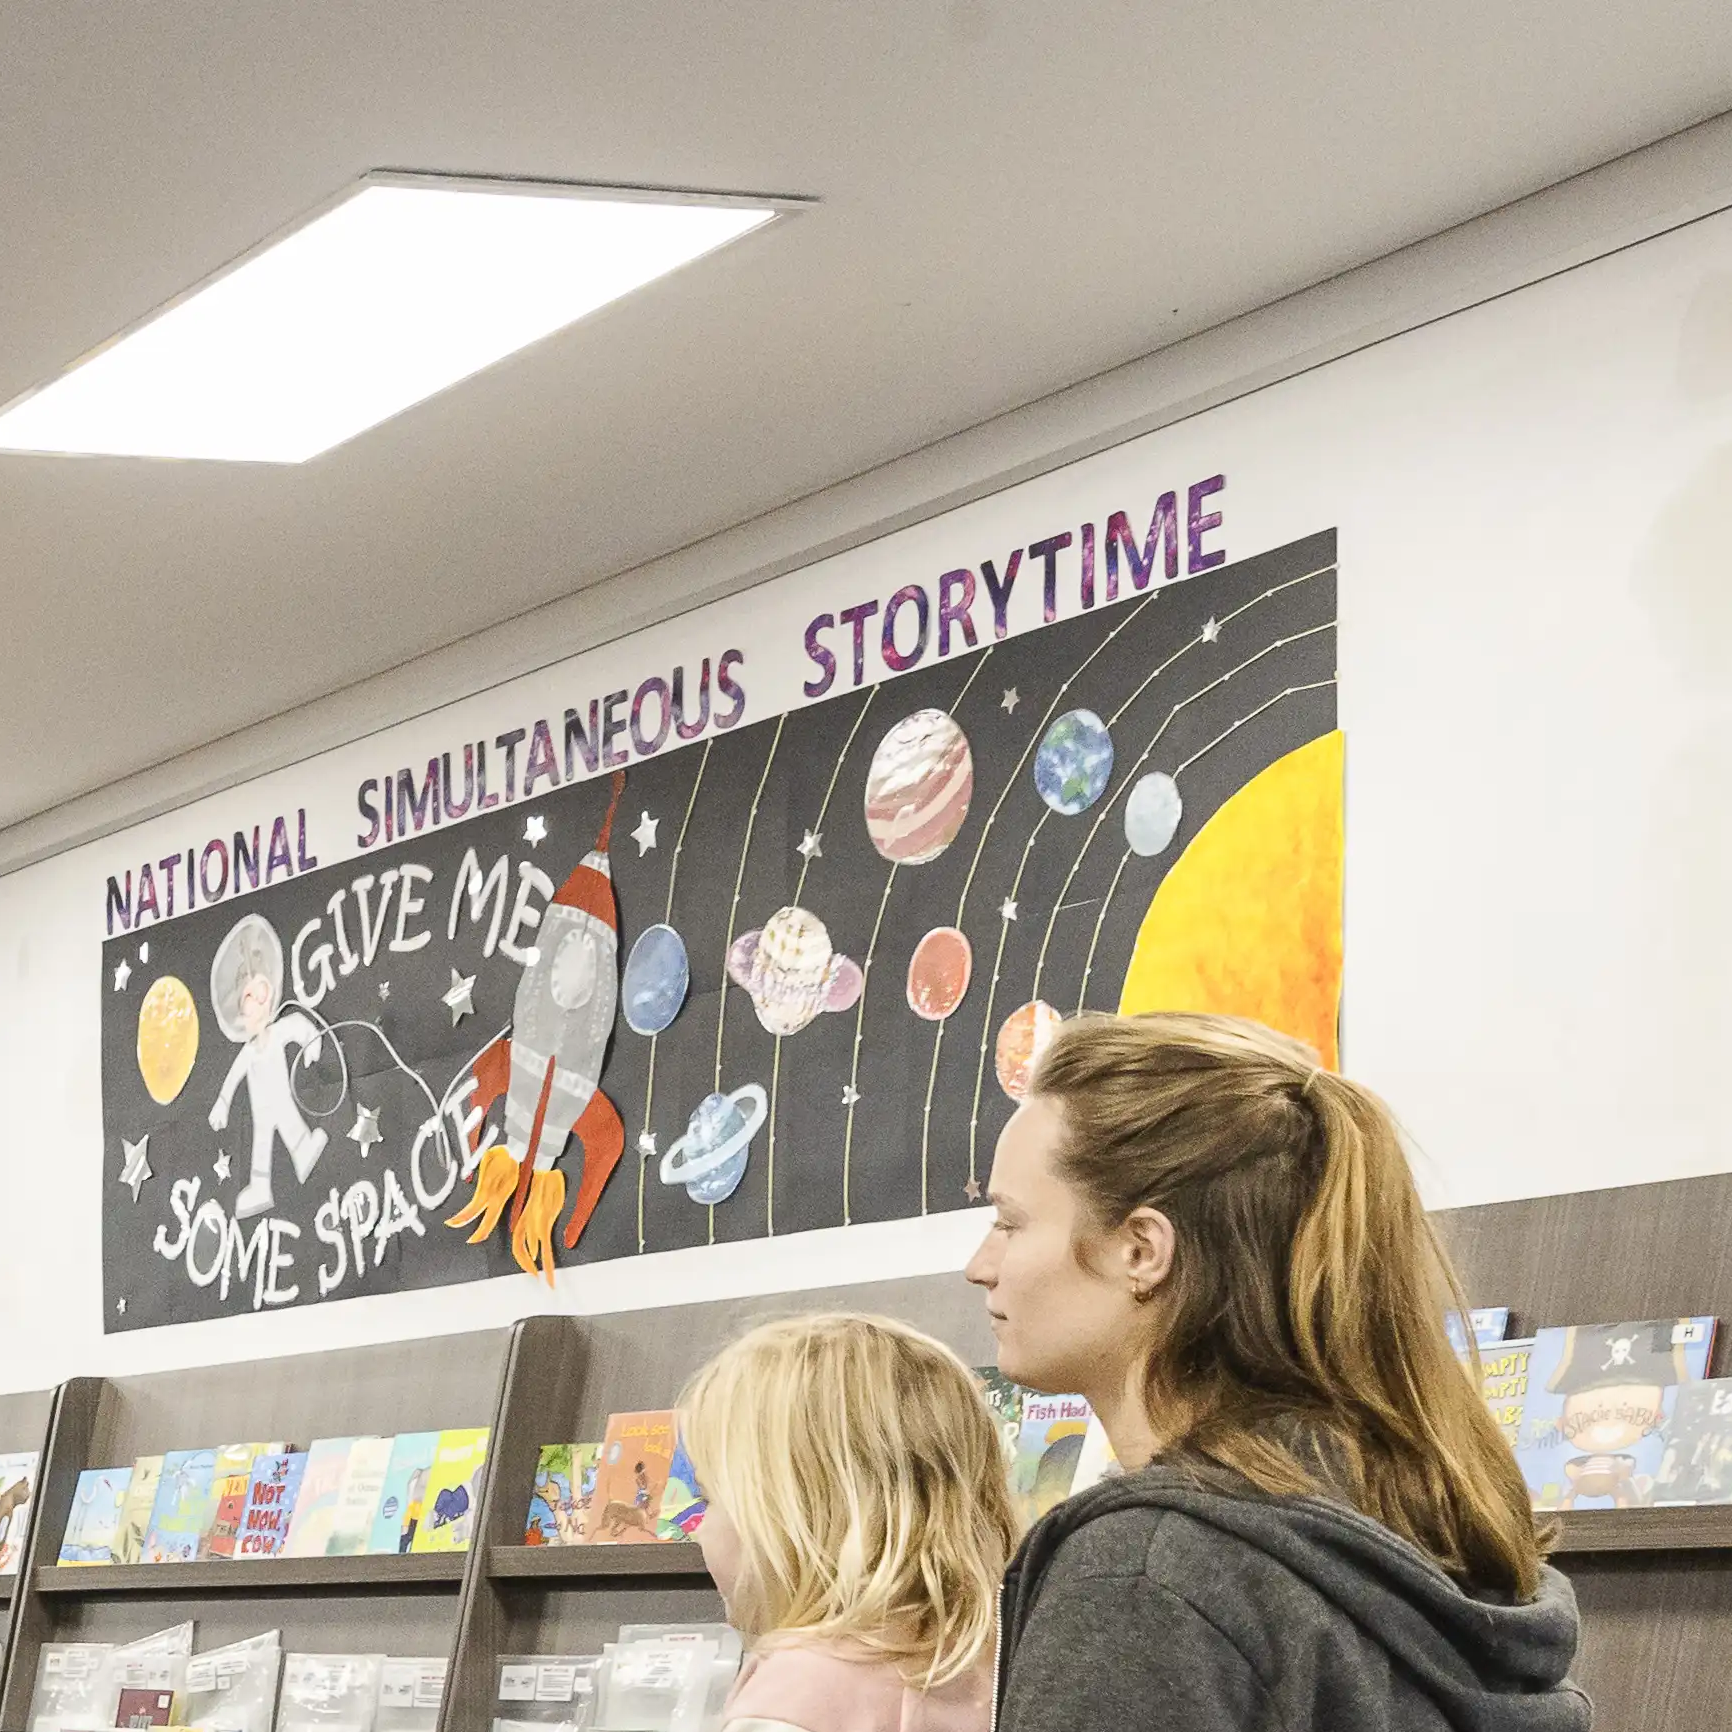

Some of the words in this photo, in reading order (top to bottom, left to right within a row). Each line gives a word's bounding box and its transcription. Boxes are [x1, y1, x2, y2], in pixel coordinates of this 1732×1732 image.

[105, 808, 318, 936] NATIONAL
[356, 648, 747, 850] SIMULTANEOUS
[801, 474, 1227, 698] STORYTIME
[291, 863, 433, 1008] GIVE
[450, 845, 556, 965] ME
[153, 1173, 301, 1309] SOME
[315, 1076, 502, 1296] SPACE
[1683, 1328, 1694, 1338] H
[1485, 1352, 1531, 1377] MPTY
[1027, 1404, 1055, 1420] Fish
[1060, 1402, 1086, 1418] Had
[252, 1480, 286, 1505] NOT
